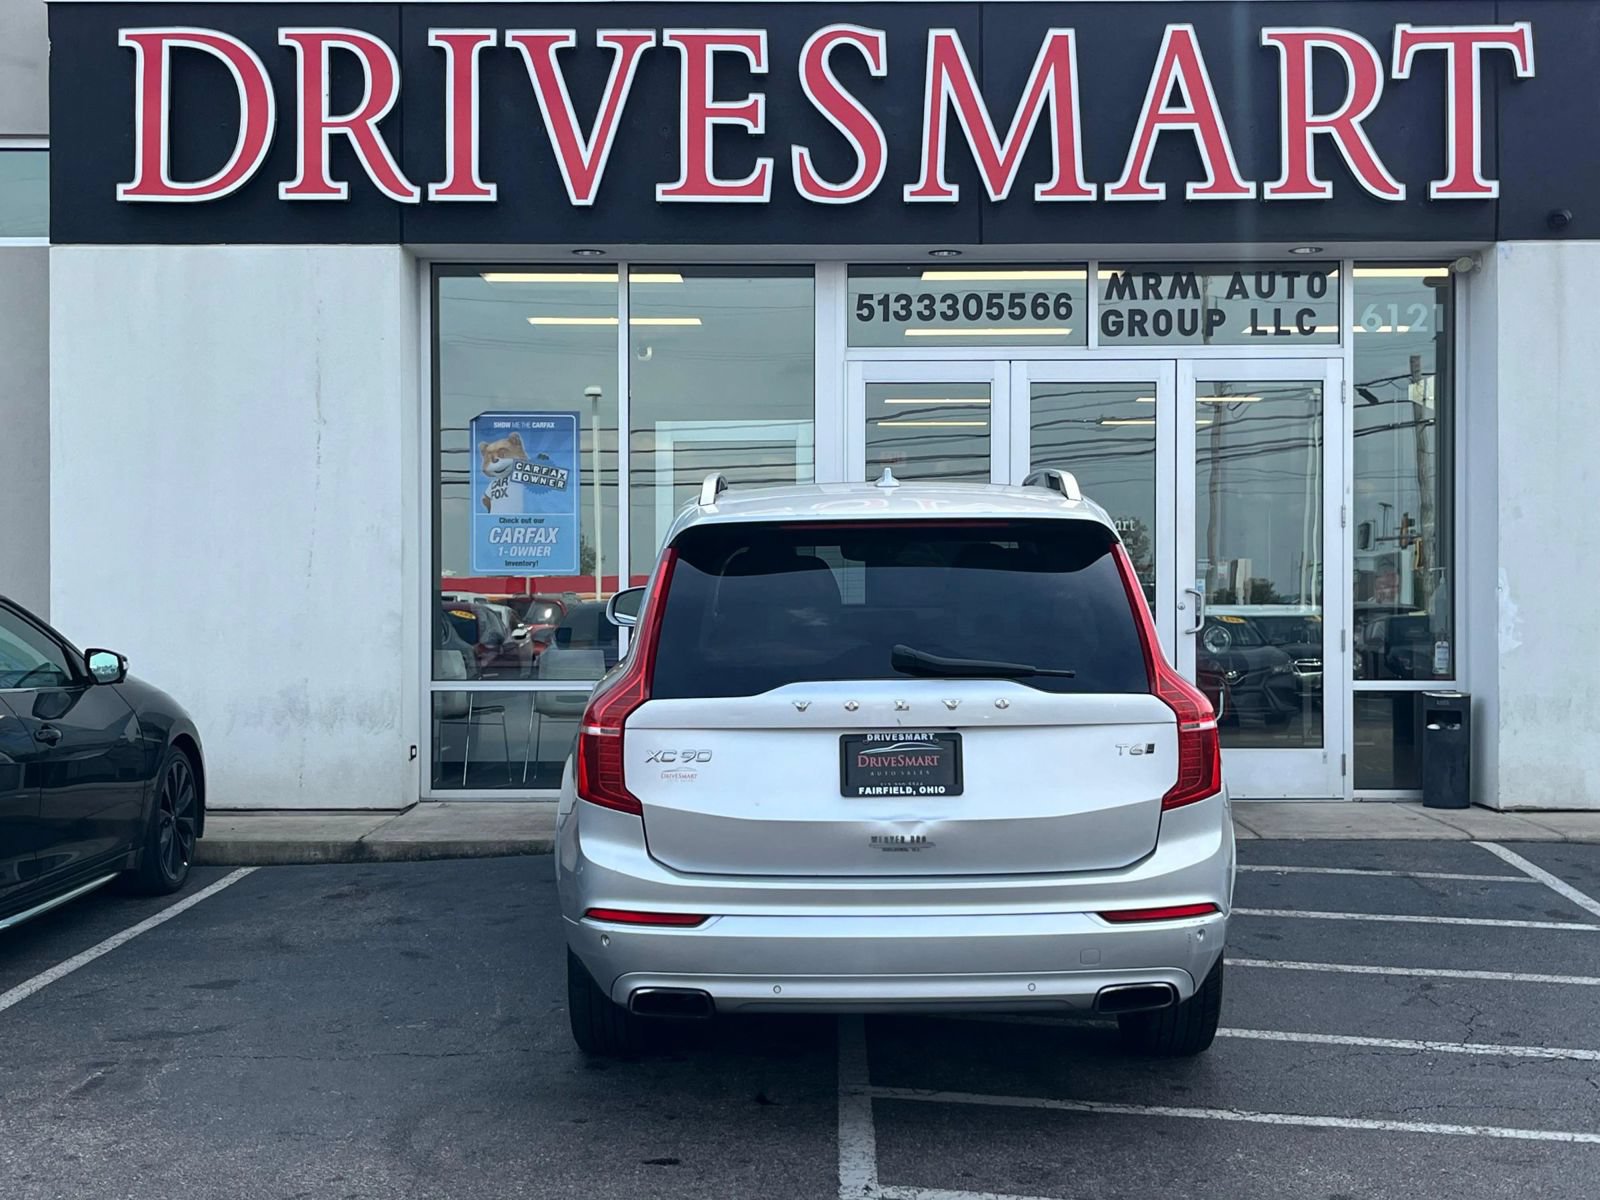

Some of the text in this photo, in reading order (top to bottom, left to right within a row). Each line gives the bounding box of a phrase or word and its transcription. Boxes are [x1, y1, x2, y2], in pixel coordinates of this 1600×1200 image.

[116, 22, 1535, 206] DRIVESMART
[1104, 271, 1328, 300] MRM AUTO
[856, 292, 1073, 322] 5133305566
[1100, 307, 1317, 337] GROUP LLC
[1360, 303, 1444, 333] 6121
[493, 421, 511, 429] SHOW
[531, 421, 555, 429] CARFAX
[515, 462, 566, 480] CARFAX
[491, 477, 509, 490] CAR
[491, 487, 509, 500] FOX
[489, 527, 560, 544] CARFAX
[498, 546, 552, 557] 1-OWNER
[505, 560, 539, 568] Inventory!
[791, 698, 1010, 712] VOLVO
[866, 733, 935, 741] DRIVESMART
[1114, 743, 1144, 756] T6
[858, 785, 946, 796] FAIRFIELD, OHIO
